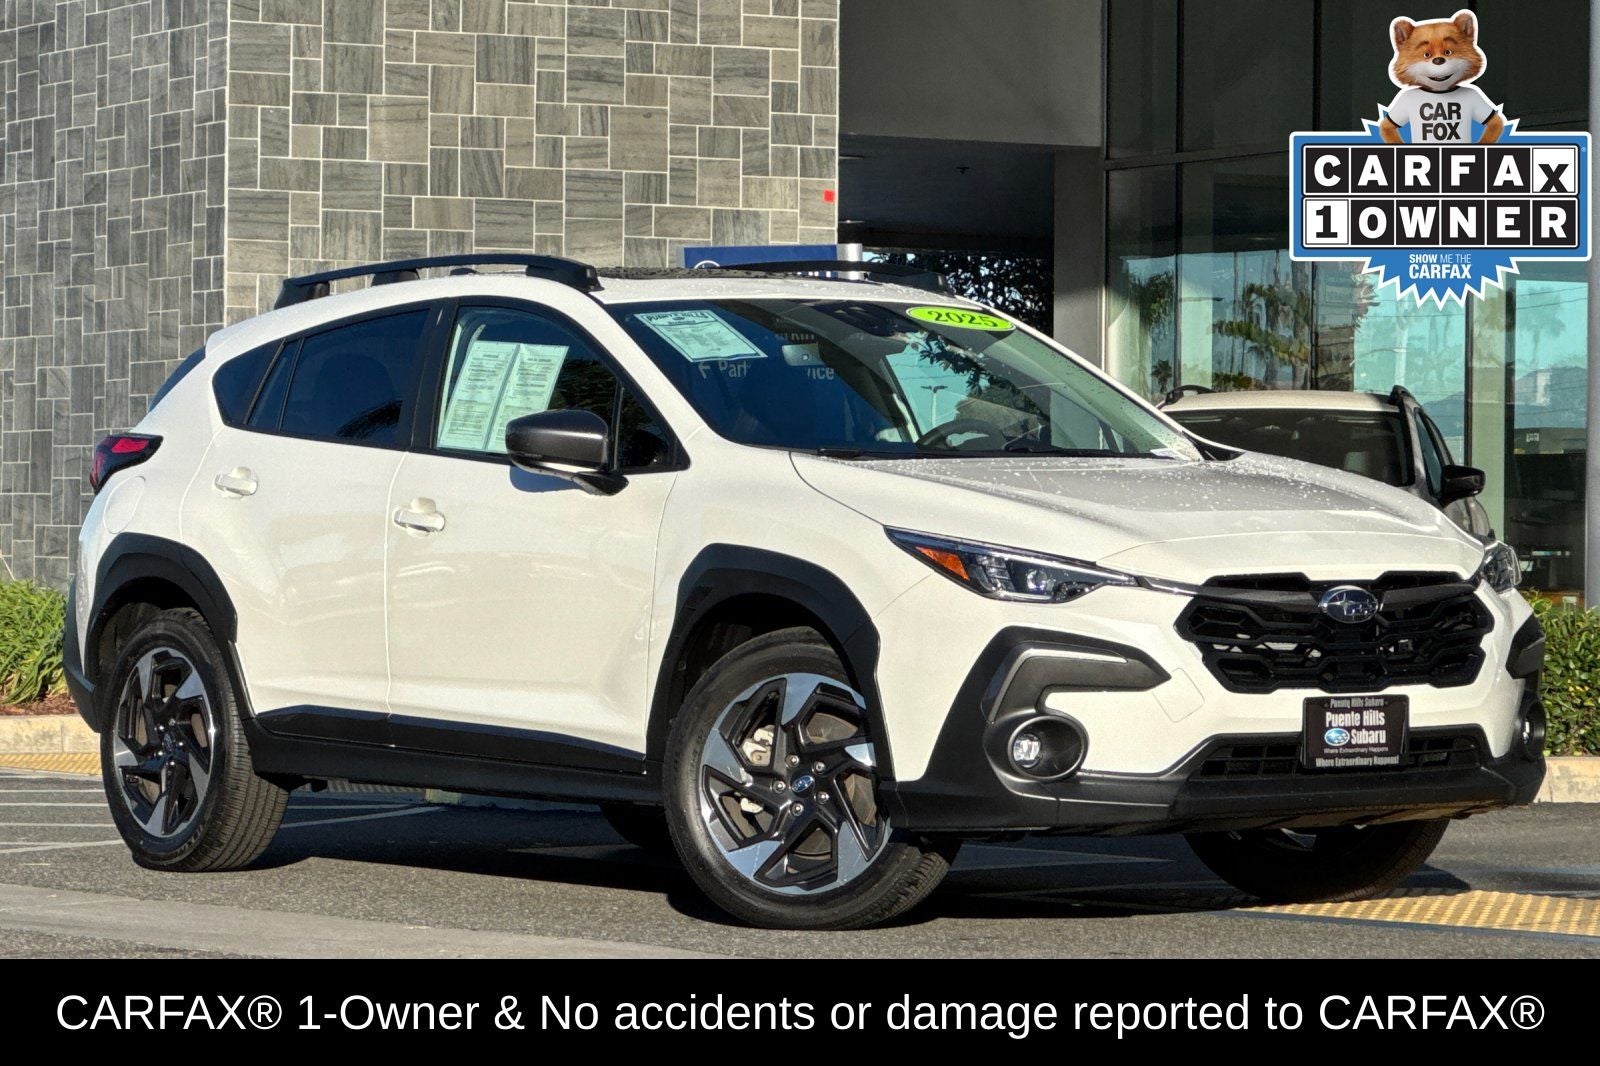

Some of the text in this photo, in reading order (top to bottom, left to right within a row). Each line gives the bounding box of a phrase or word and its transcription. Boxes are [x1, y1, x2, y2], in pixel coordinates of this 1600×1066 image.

[927, 310, 999, 328] 2025
[1326, 710, 1386, 728] Puente Hills
[1351, 728, 1386, 744] Subaru
[1316, 758, 1334, 767] Where
[1335, 756, 1373, 766] Extraordinary
